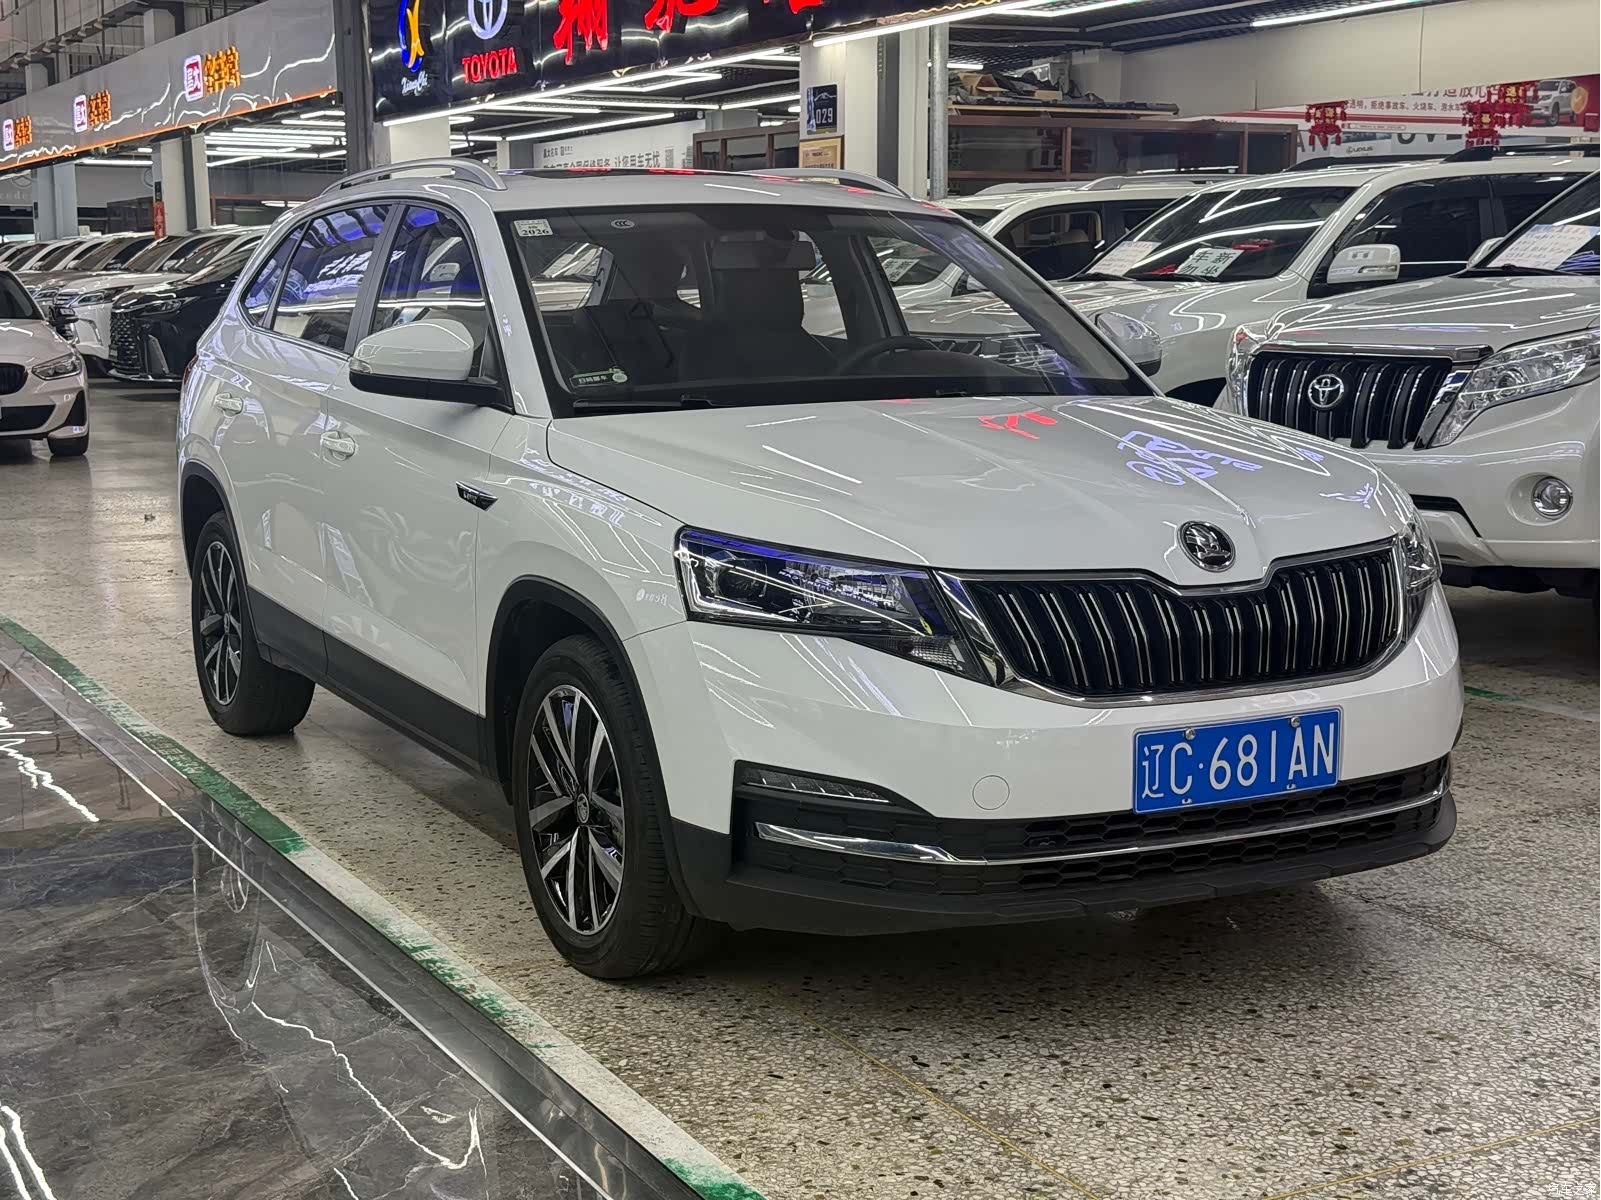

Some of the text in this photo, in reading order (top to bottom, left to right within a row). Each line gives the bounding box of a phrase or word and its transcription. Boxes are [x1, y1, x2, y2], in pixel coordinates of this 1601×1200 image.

[462, 47, 518, 83] TOYOTA
[815, 107, 834, 124] 029
[521, 228, 550, 237] 2026
[1141, 722, 1335, 799] 辽C·681AN
